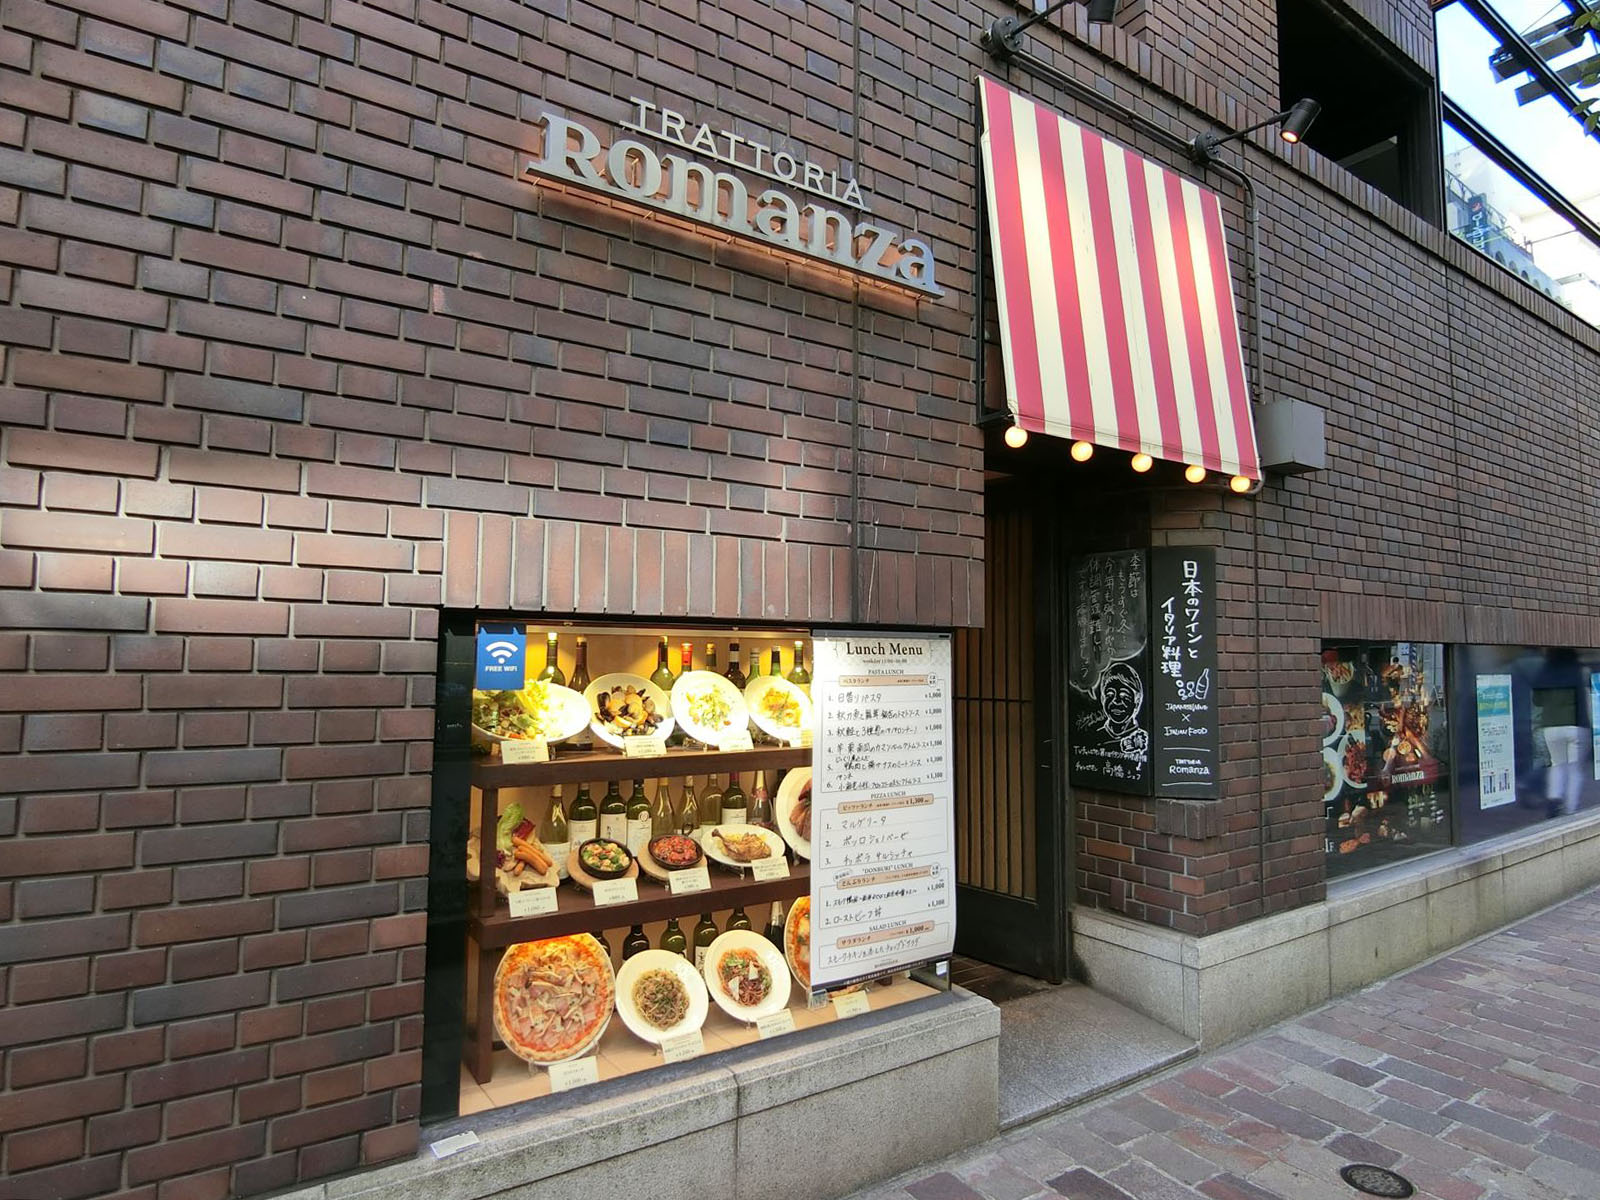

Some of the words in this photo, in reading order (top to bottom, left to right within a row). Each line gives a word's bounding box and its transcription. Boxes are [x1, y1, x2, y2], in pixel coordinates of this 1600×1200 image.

[626, 96, 868, 210] TRATTORIA
[526, 112, 945, 298] Romanza
[1181, 560, 1203, 659] 日本のワインと
[846, 641, 886, 655] Lunch
[888, 642, 923, 655] Menu
[485, 665, 503, 673] FREE
[1169, 765, 1210, 775] Romanza
[894, 862, 913, 870] LUNCH
[833, 906, 883, 923] ローストビーフ丼
[886, 920, 907, 928] LUNCH
